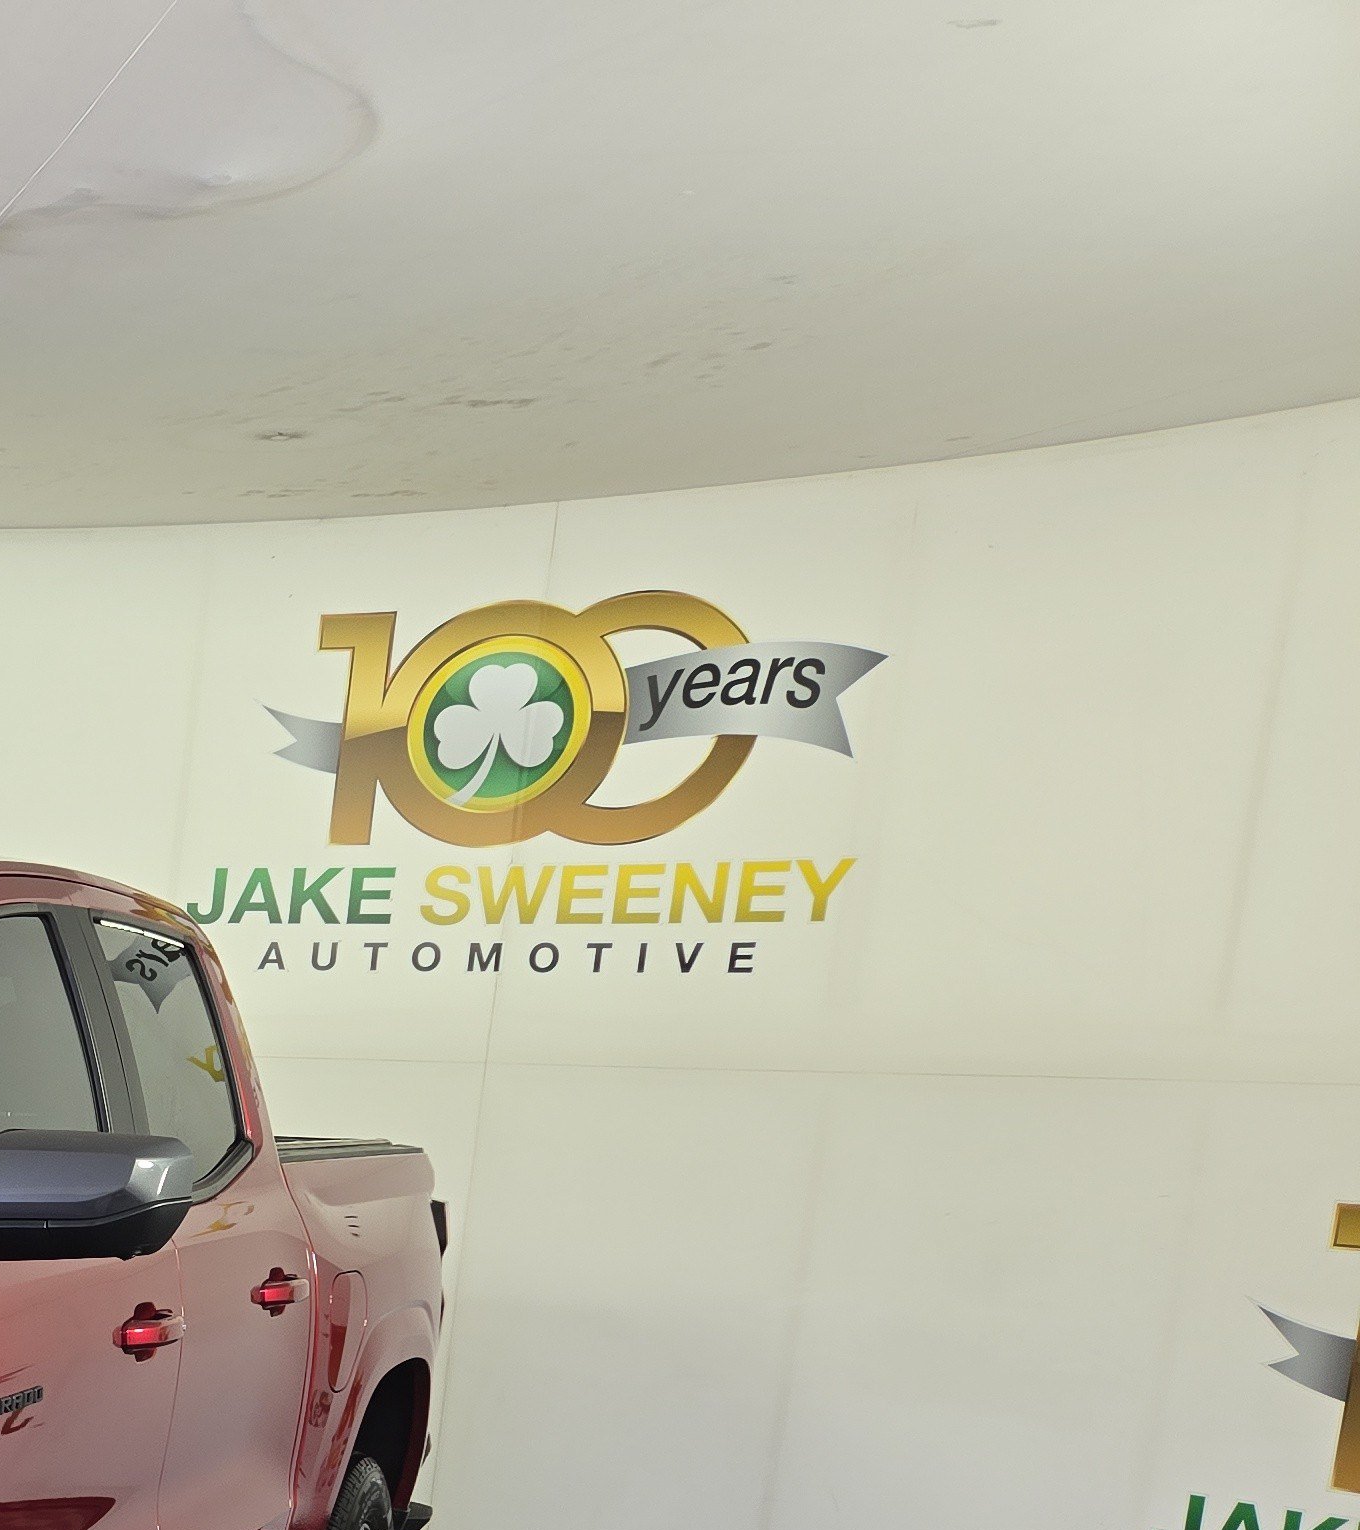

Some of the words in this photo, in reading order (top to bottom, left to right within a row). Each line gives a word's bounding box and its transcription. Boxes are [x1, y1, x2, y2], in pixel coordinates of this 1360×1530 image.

[319, 590, 757, 848] 100
[639, 655, 826, 733] years
[186, 867, 397, 925] JAKE
[419, 857, 857, 926] SWEENEY
[257, 941, 757, 974] AUTOMOTIVE
